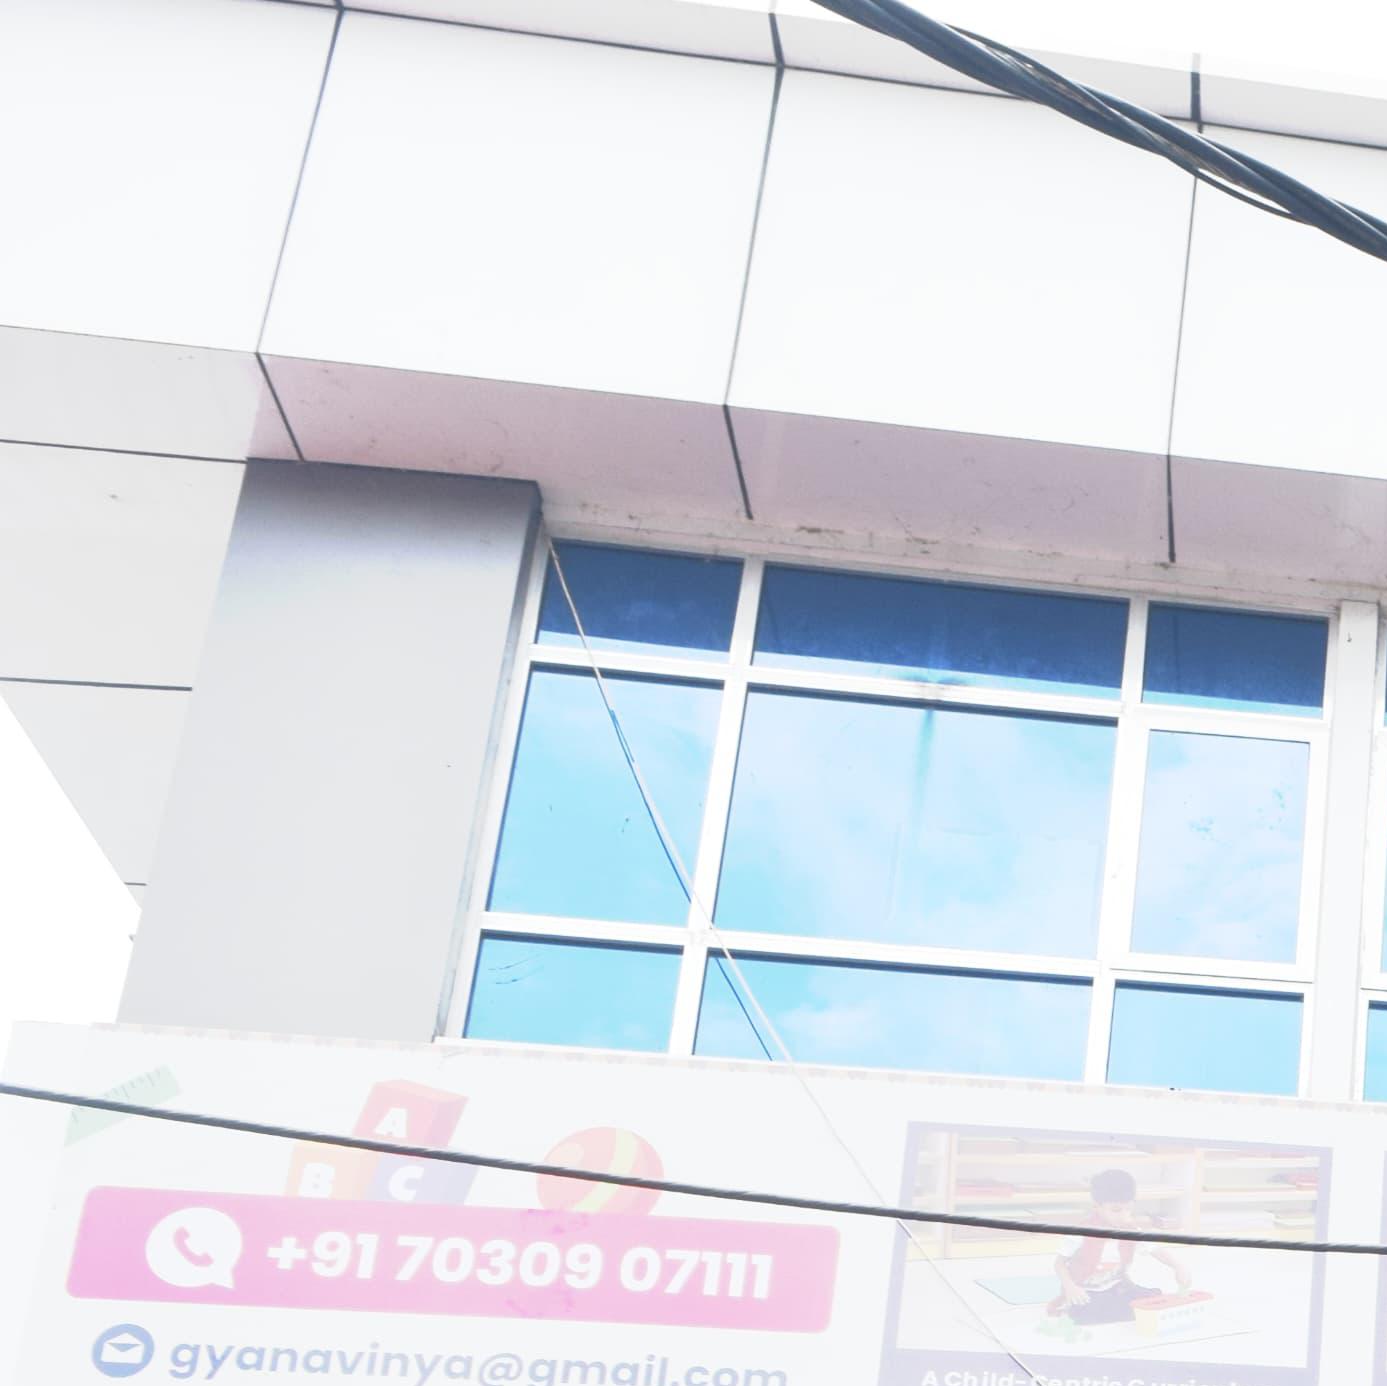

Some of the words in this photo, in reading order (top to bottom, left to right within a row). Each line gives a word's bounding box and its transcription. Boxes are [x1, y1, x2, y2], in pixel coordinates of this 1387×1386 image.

[373, 1108, 409, 1139] A
[298, 1162, 335, 1199] B
[387, 1166, 425, 1201] C
[267, 1232, 376, 1280] +91
[396, 1234, 603, 1290] 70309
[619, 1246, 772, 1300] 07111
[921, 1371, 938, 1386] A
